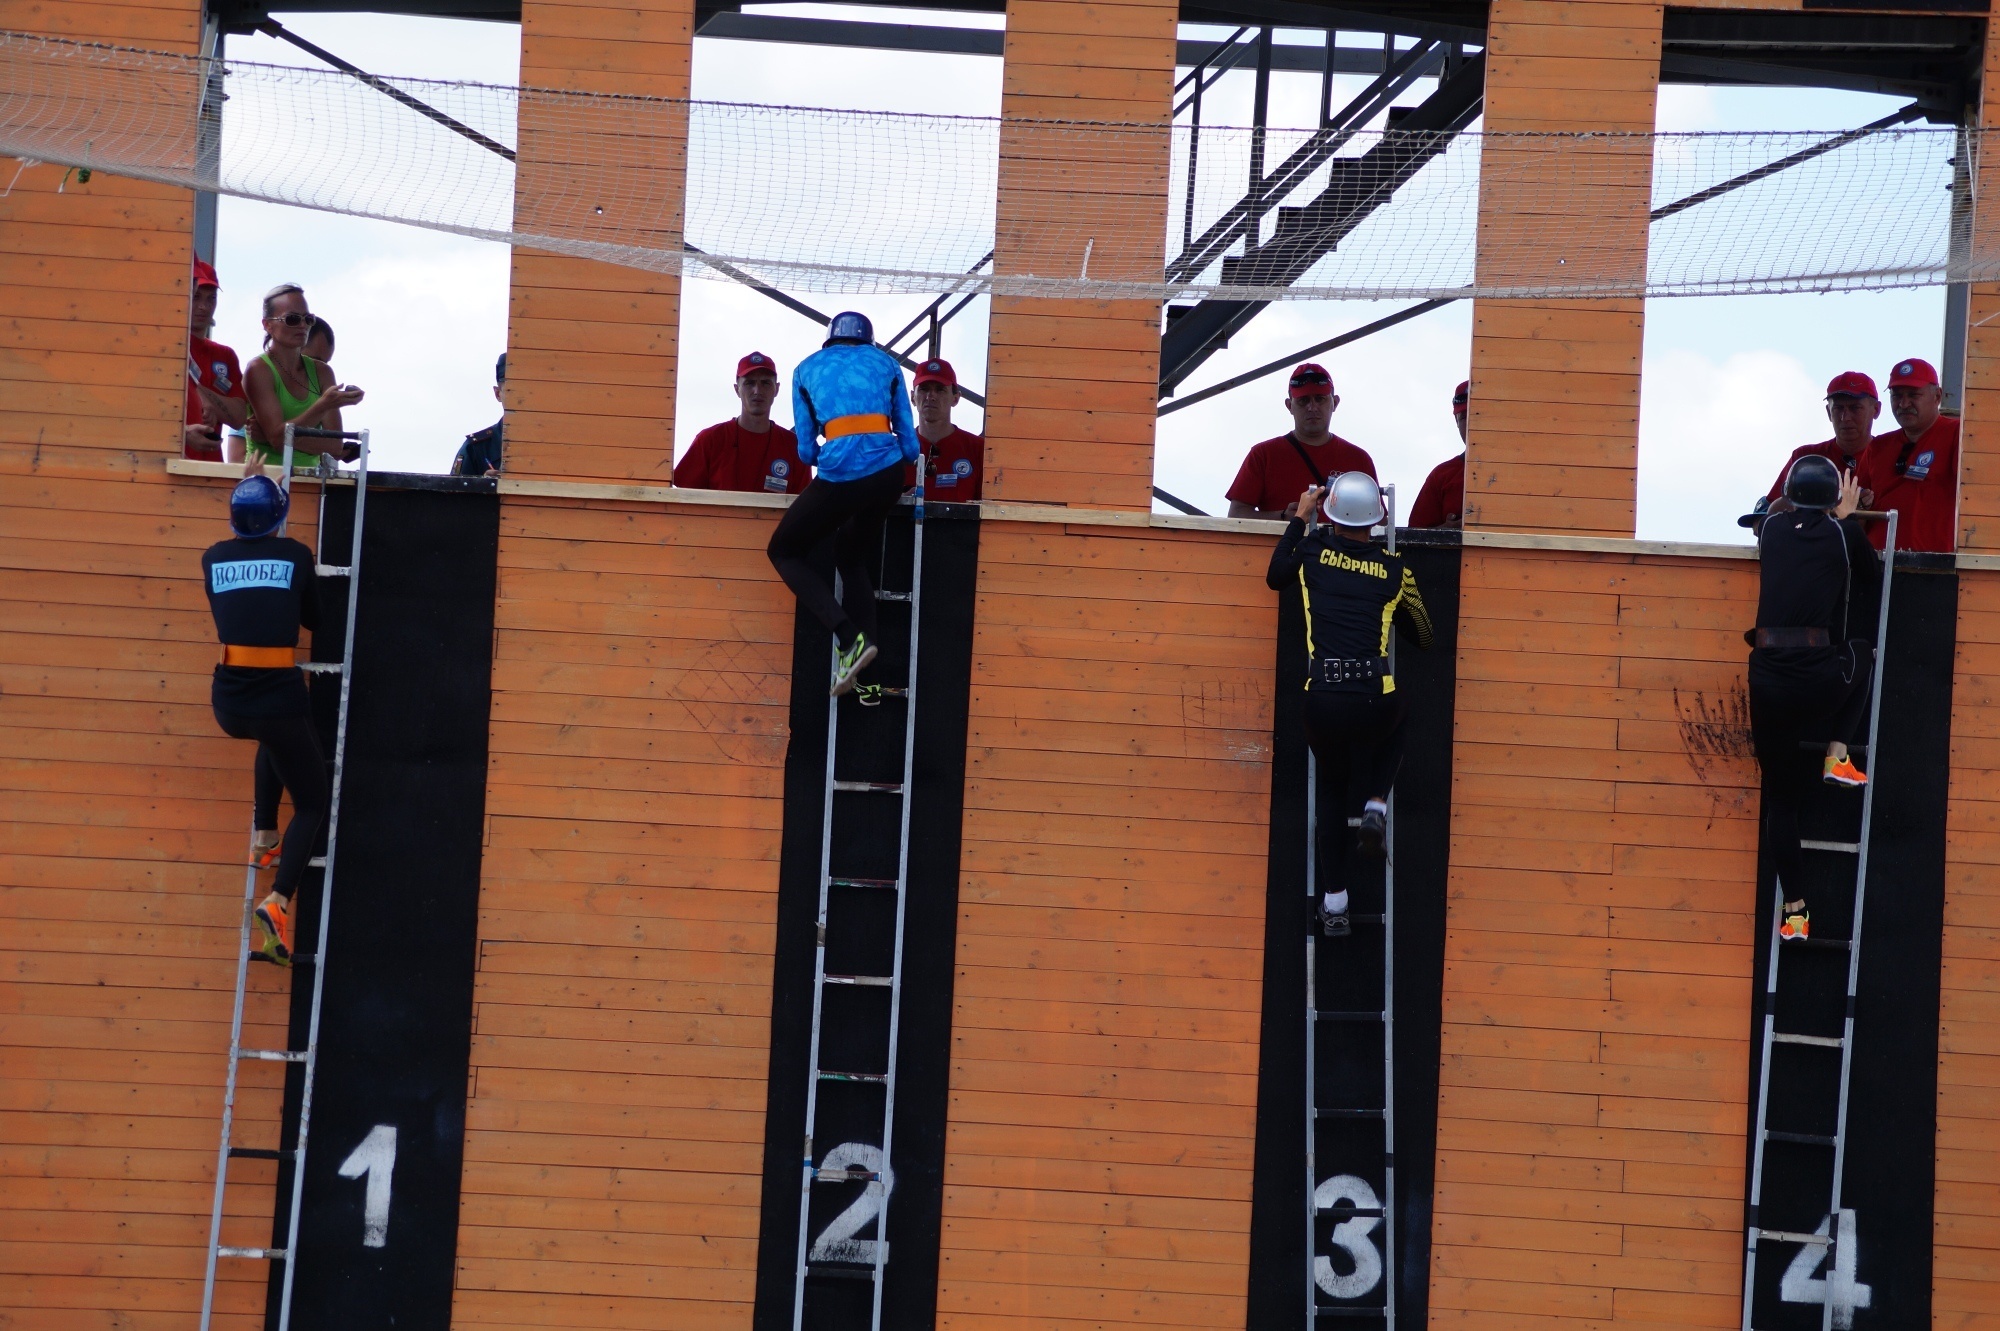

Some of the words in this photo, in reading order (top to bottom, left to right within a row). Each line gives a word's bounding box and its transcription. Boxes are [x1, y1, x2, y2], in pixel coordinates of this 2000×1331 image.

[215, 563, 290, 586] ПОДОБЕД
[1319, 548, 1388, 579] СЫЗРАНЬ
[338, 1124, 397, 1248] 1
[809, 1142, 895, 1265] 2
[1311, 1174, 1383, 1299] 3
[1780, 1208, 1872, 1330] 4
